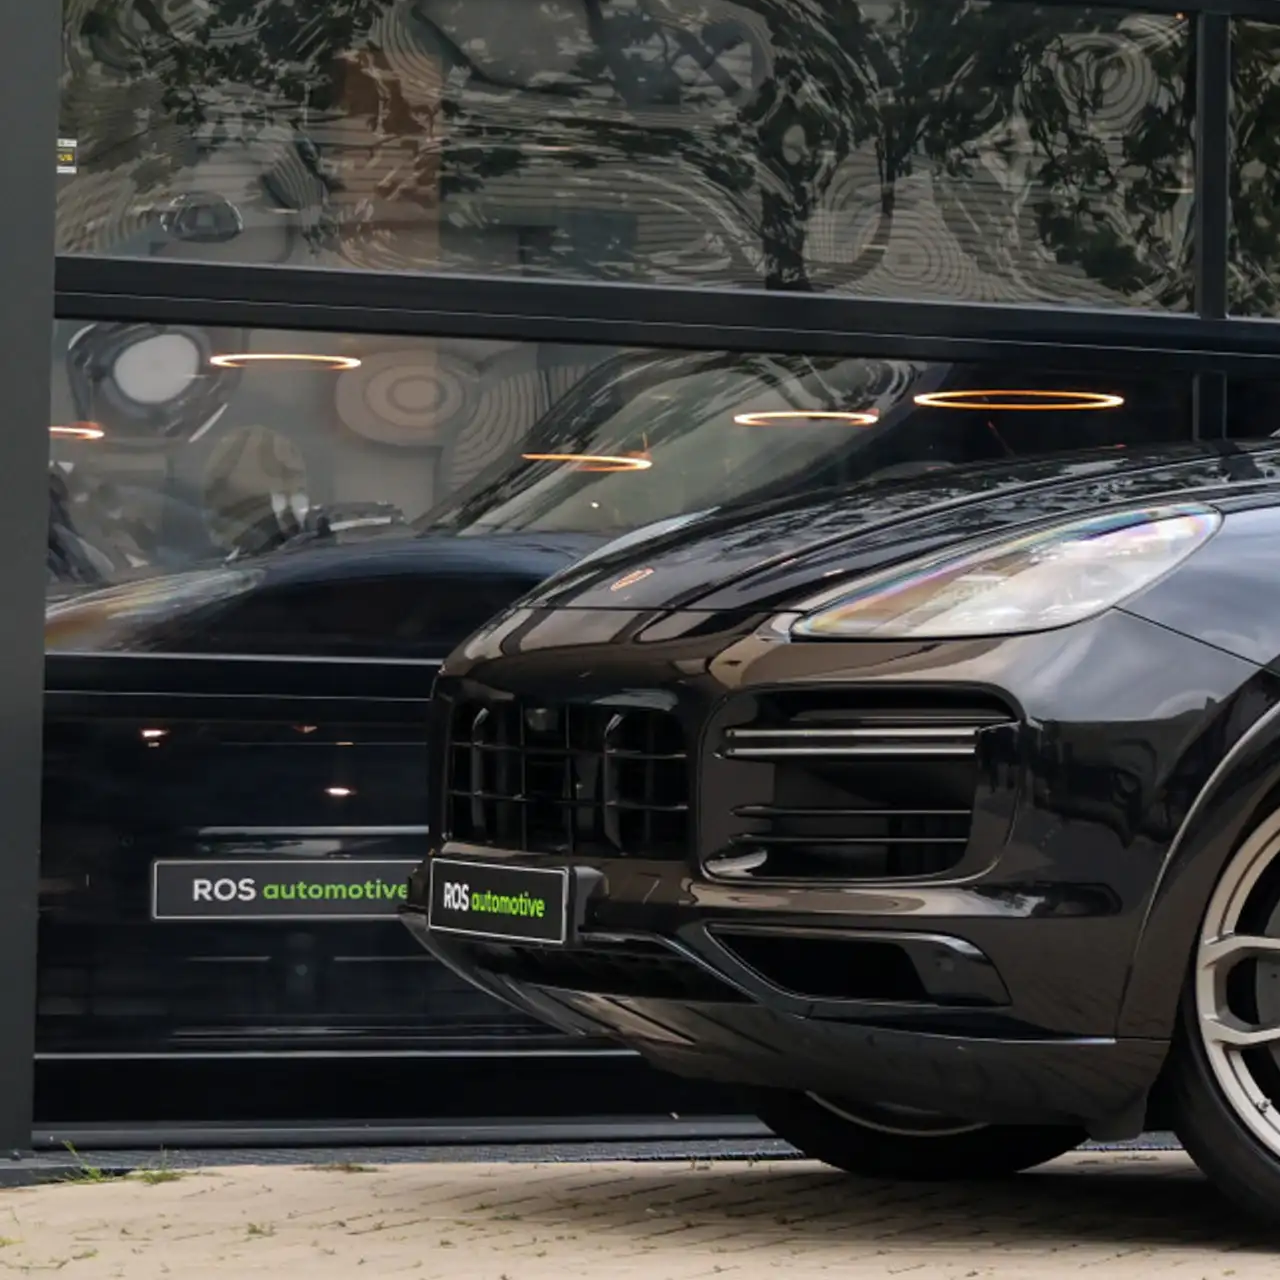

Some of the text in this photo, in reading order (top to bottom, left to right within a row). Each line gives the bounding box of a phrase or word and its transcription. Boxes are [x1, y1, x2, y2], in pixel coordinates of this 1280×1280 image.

[193, 878, 409, 901] ROS automotive
[443, 882, 545, 917] ROS automotive
